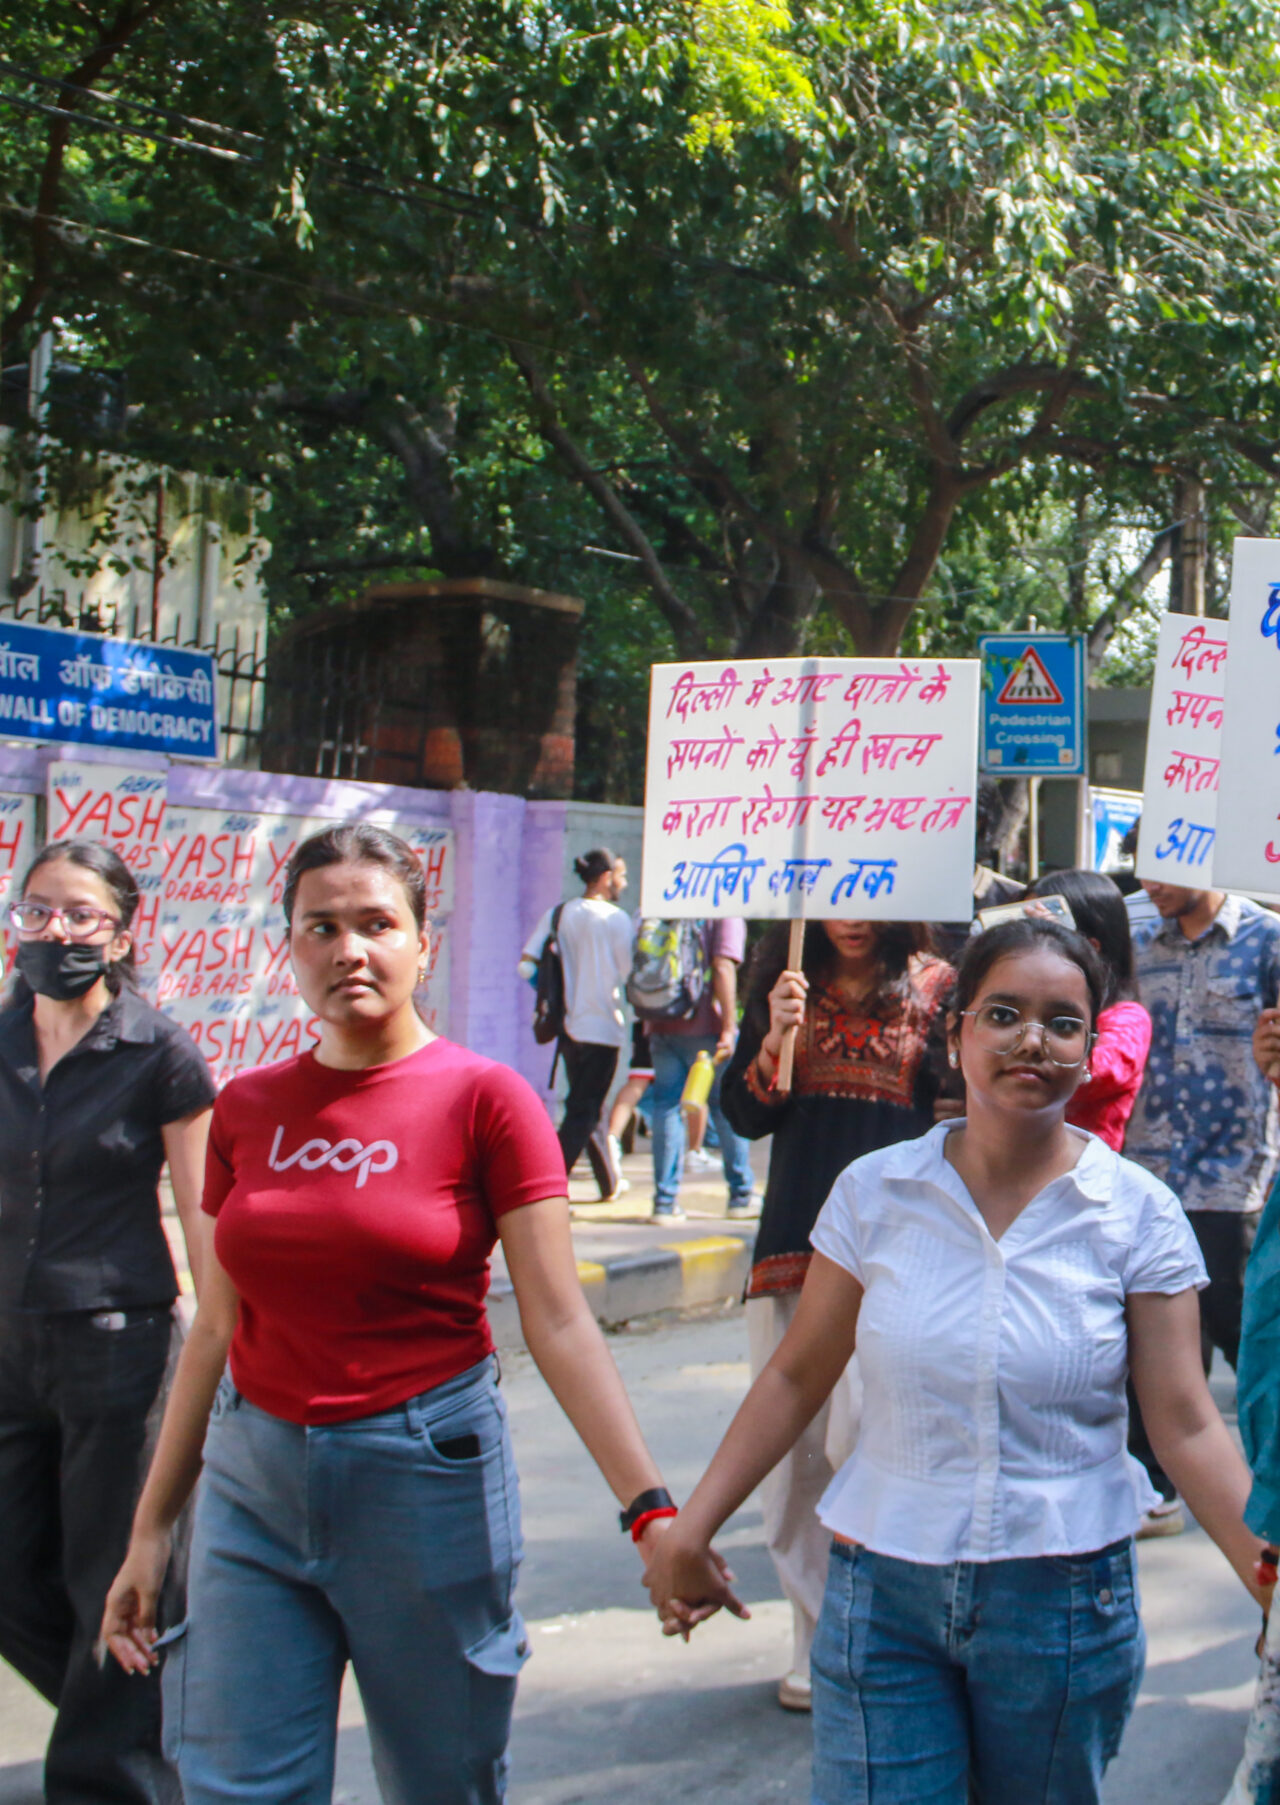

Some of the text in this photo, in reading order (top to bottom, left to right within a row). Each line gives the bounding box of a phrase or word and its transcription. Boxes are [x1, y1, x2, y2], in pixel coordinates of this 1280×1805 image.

[666, 668, 742, 723] दिल्ली
[919, 664, 951, 704] के
[58, 700, 87, 727] OF
[91, 704, 213, 743] DEMOCRACY
[990, 713, 1071, 726] Pedestrian
[996, 732, 1065, 747] Crossing
[667, 725, 744, 779] सपनों
[746, 724, 786, 770] को
[816, 718, 861, 777] ही
[862, 734, 943, 774] खत्म
[53, 788, 167, 842] YASH
[662, 796, 742, 838] करता
[742, 784, 819, 835] रहेगा
[822, 795, 867, 831] यह
[161, 833, 255, 880] YASH
[664, 843, 898, 907] आखिर कब तक
[164, 879, 252, 904] DABAAS
[160, 927, 255, 972] YASH
[158, 973, 255, 998] DABAAS
[178, 1018, 251, 1063] ASH
